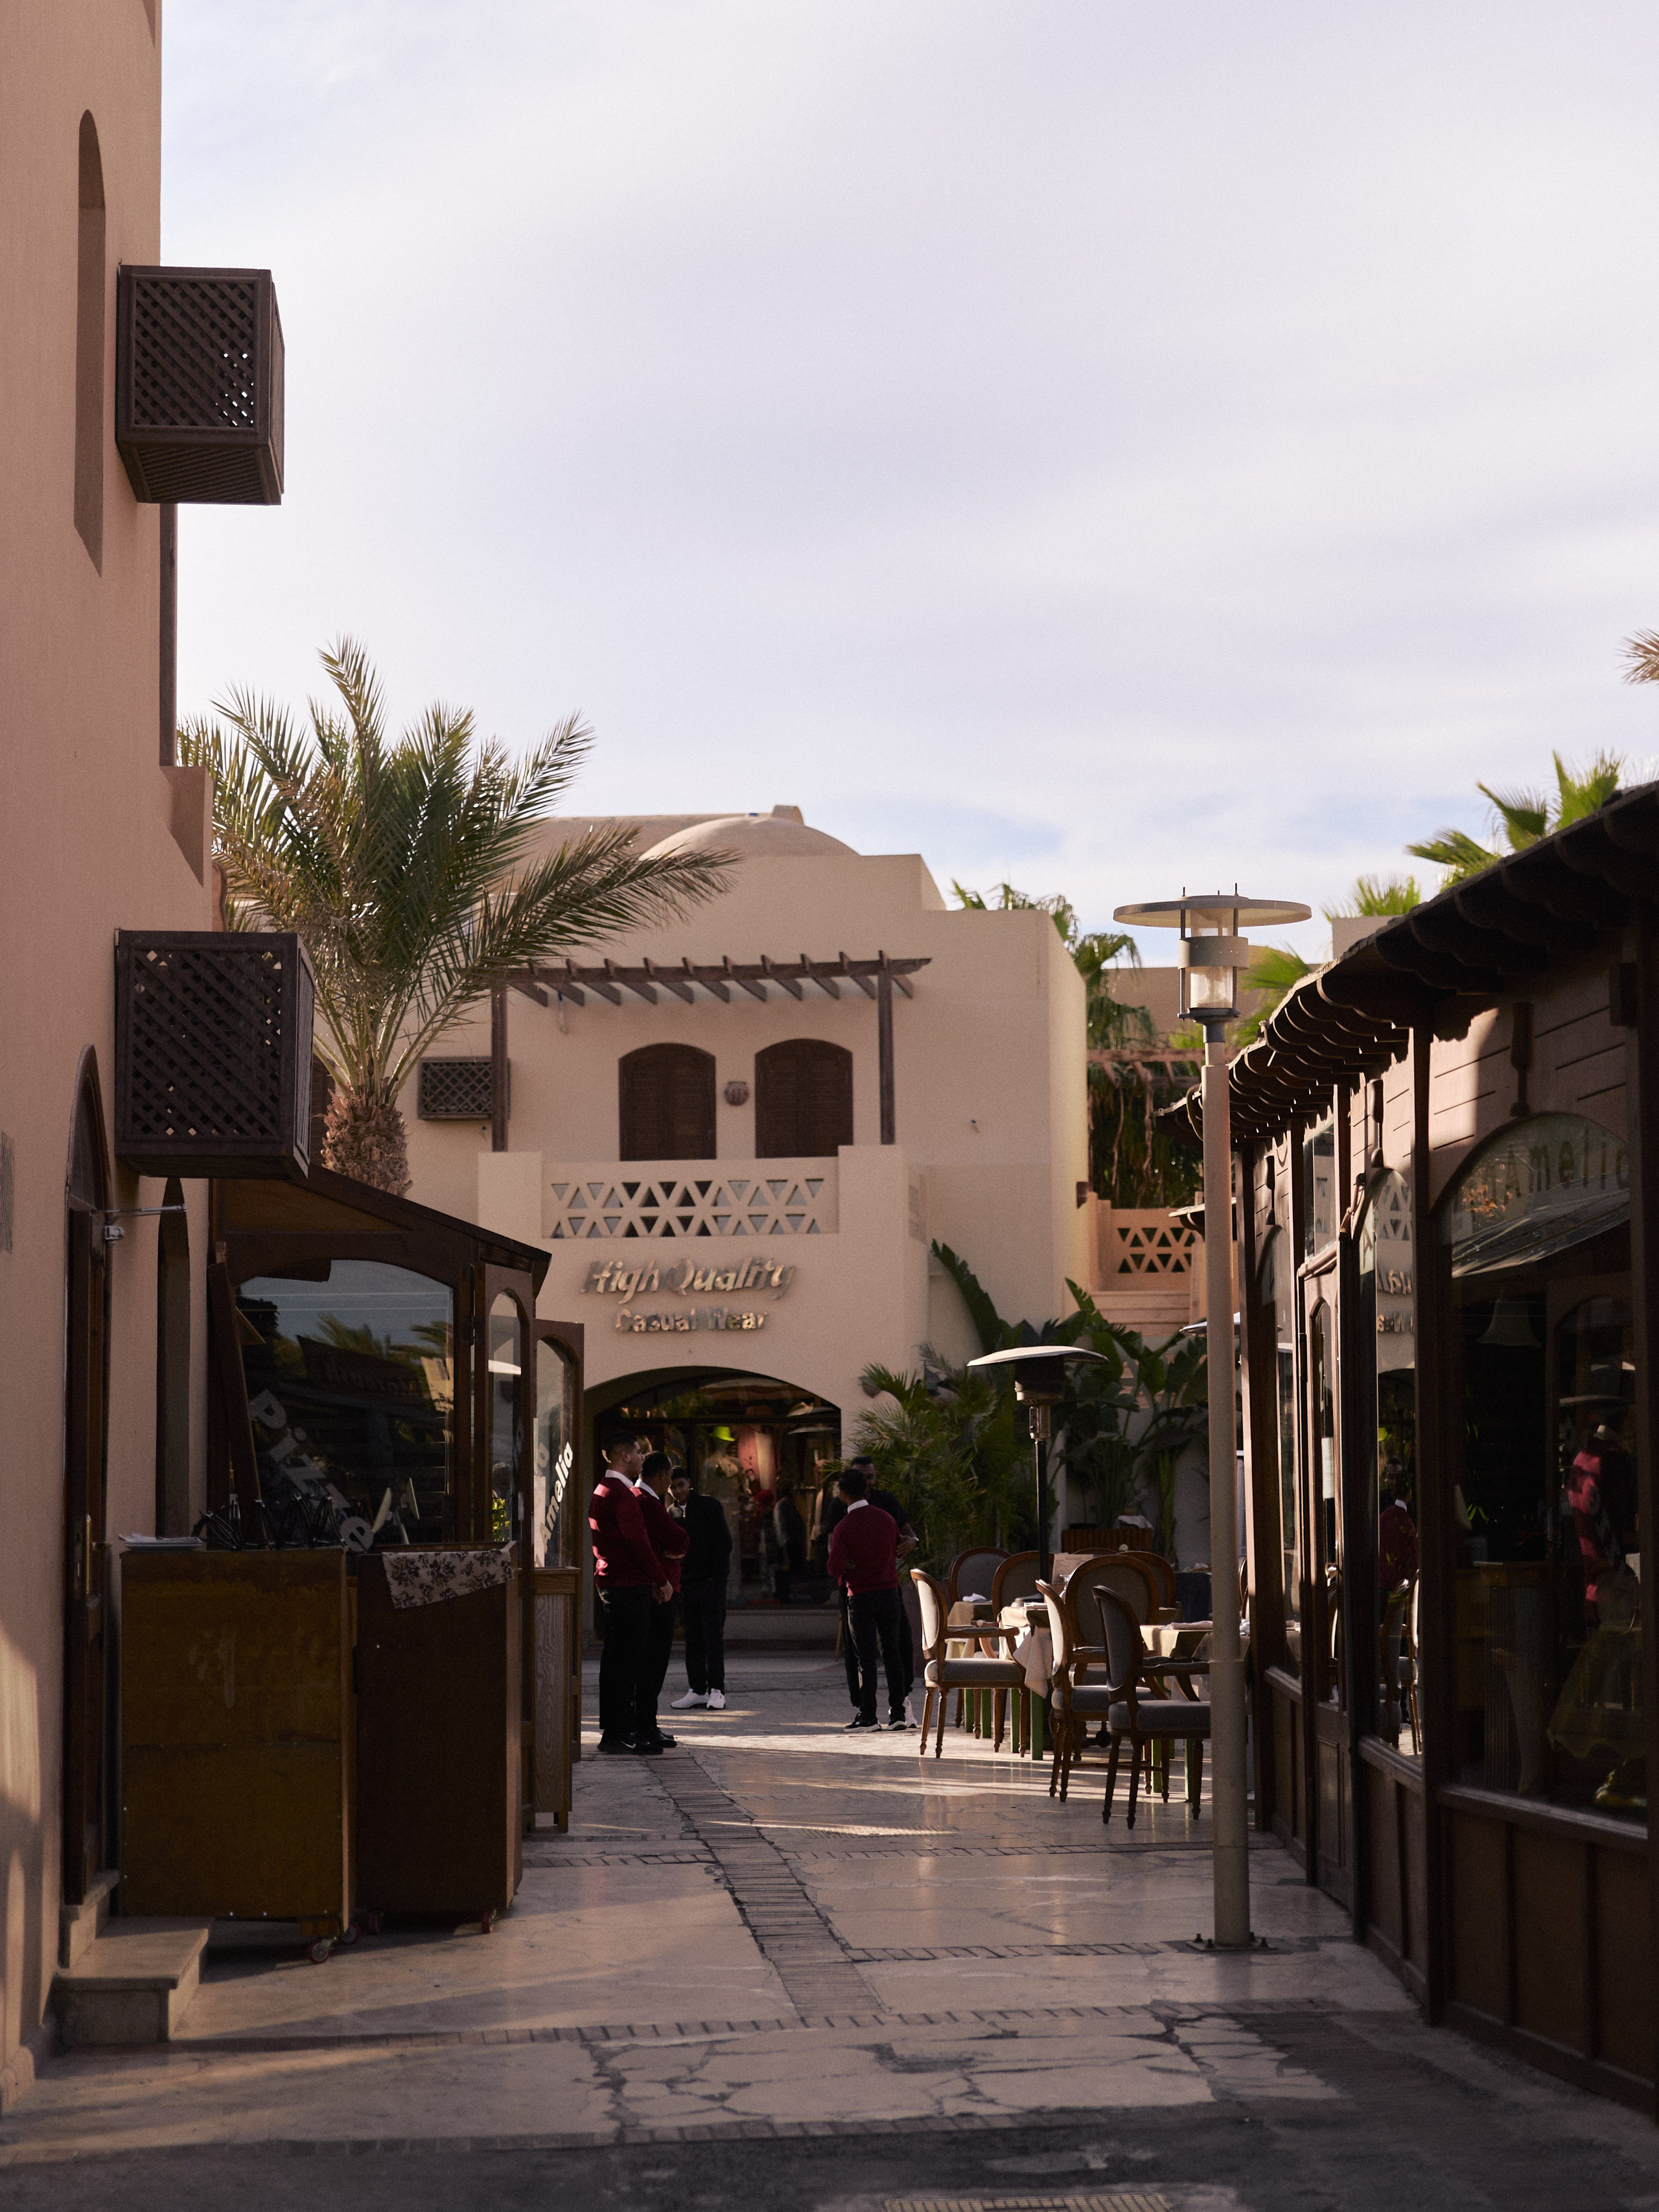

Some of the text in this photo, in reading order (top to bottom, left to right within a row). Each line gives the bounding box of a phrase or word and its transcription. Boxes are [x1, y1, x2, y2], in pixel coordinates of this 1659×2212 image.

[581, 1255, 796, 1304] High Quality
[616, 1307, 769, 1332] Casual Wear
[540, 1441, 573, 1554] Amelia
